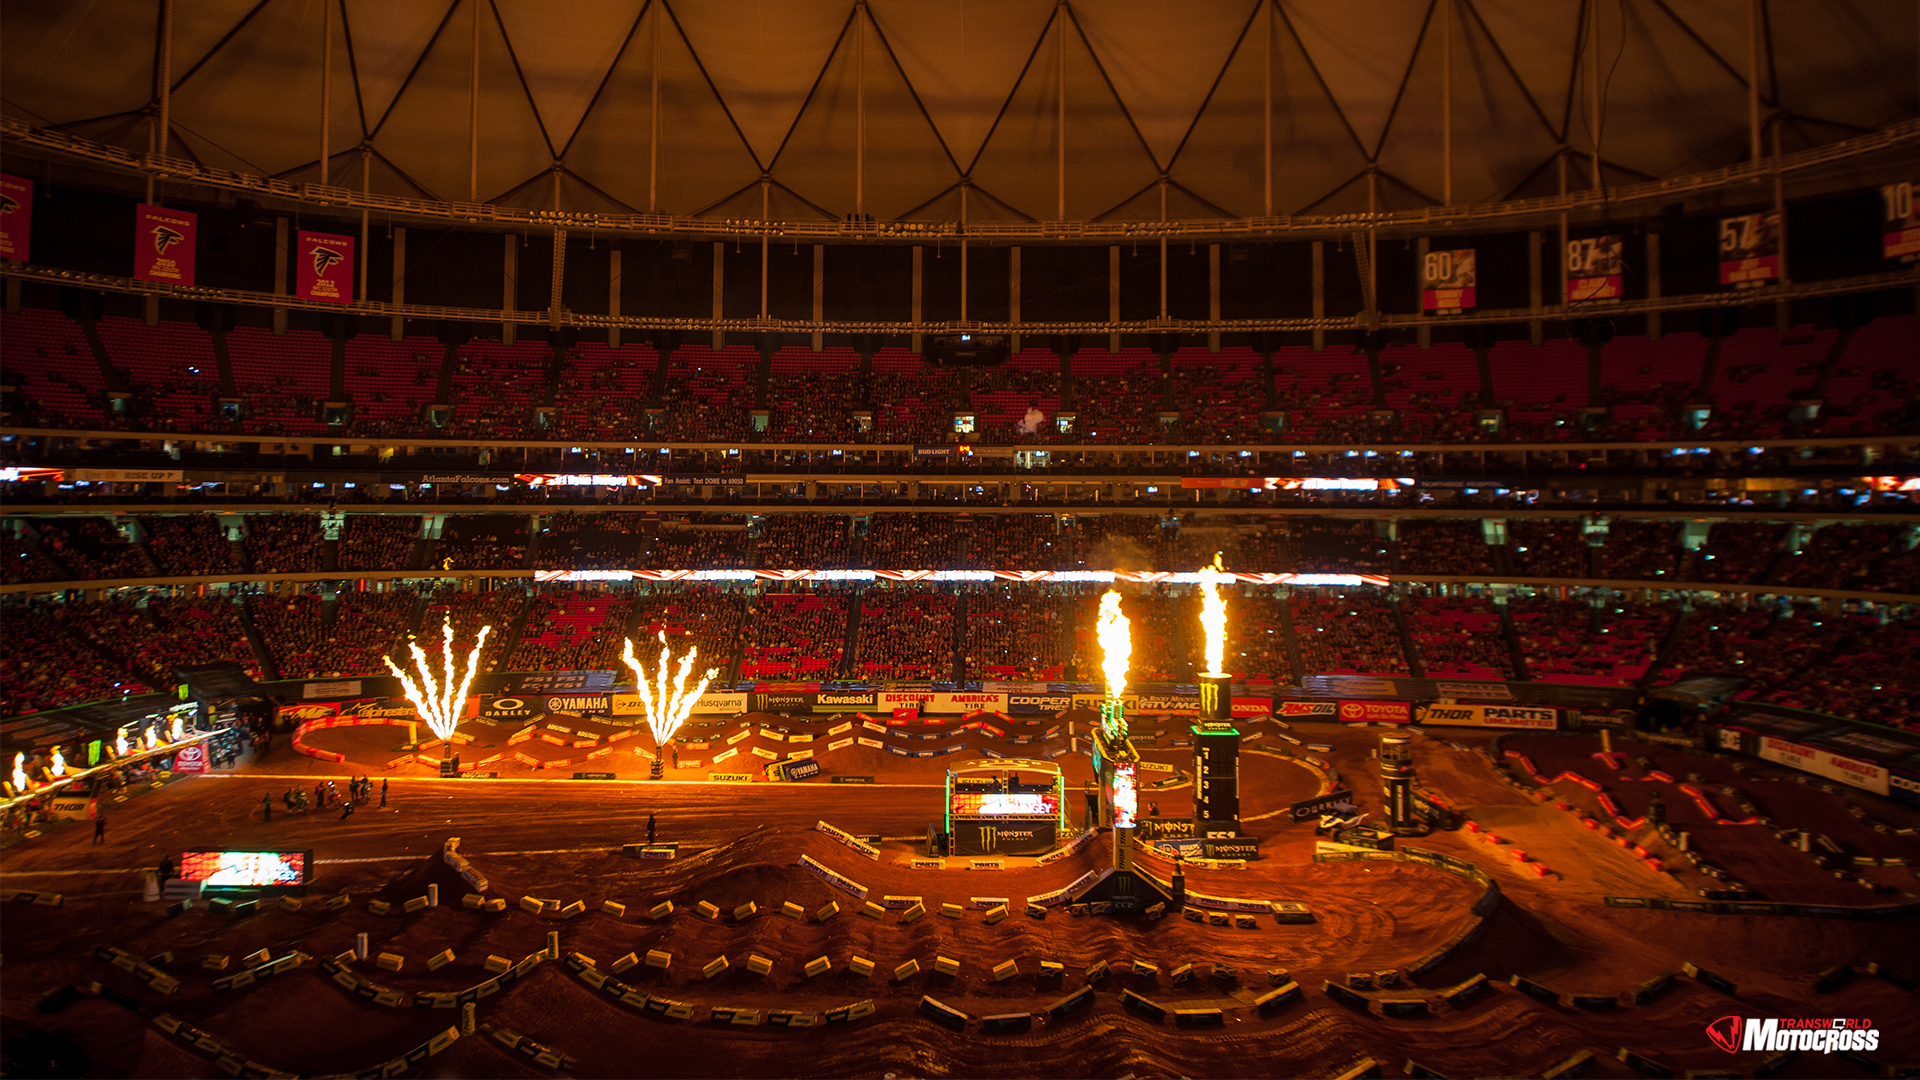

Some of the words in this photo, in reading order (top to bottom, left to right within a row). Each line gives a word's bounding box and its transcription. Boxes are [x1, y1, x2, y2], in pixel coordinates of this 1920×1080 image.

[1882, 184, 1913, 222] 10
[145, 213, 190, 227] FALCONS
[1719, 216, 1751, 251] 57
[306, 237, 348, 246] FALCONS
[1567, 238, 1597, 271] 87
[1424, 251, 1452, 281] 60
[316, 279, 336, 287] 2012
[124, 472, 149, 480] RISE
[151, 472, 166, 480] UP
[421, 474, 510, 484] AtlantaFalcons.com
[556, 675, 585, 683] FS1
[769, 696, 804, 704] MONSTER
[817, 694, 873, 704] Kawasaki
[885, 694, 935, 703] DISCOUNT
[951, 693, 999, 703] AMERICA'S
[1009, 696, 1071, 705] COOPER
[562, 697, 609, 710] YAMAHA
[696, 699, 742, 708] Husqvarna
[1231, 704, 1270, 712] ONDA
[485, 709, 532, 717] OAKLEY
[1278, 702, 1336, 715] AMSOIL
[1366, 704, 1409, 714] TOYOTA
[1429, 708, 1474, 720] THOR
[1483, 708, 1554, 720] PARTS
[1483, 718, 1554, 728] UNLIMITED
[1203, 752, 1210, 760] 1
[796, 763, 819, 775] YAMAHA
[1203, 766, 1210, 774] 2
[713, 774, 748, 782] SUZUKI
[1203, 781, 1210, 789] 3
[1203, 796, 1210, 804] 4
[54, 803, 86, 811] THOR
[1203, 810, 1210, 819] 5
[997, 830, 1034, 838] MONSTER
[1215, 844, 1258, 853] MONSTER
[803, 860, 828, 879] PARTS
[836, 877, 861, 894] PARTS
